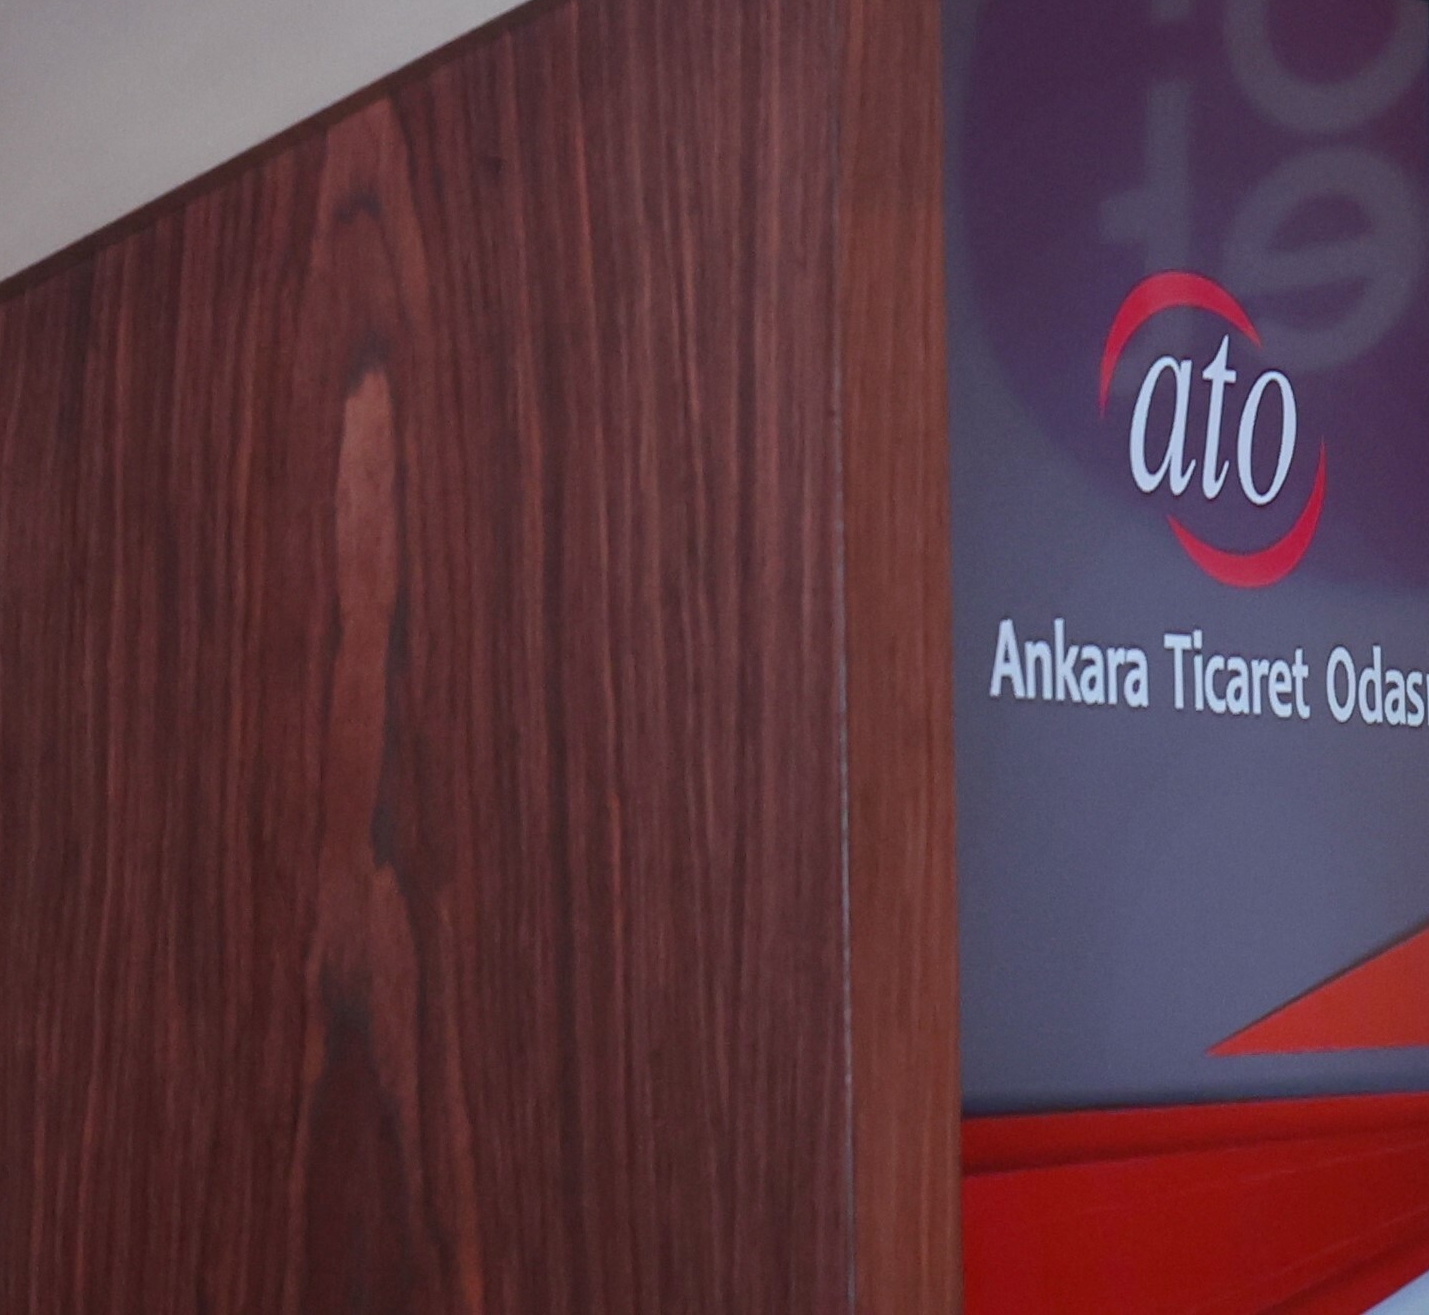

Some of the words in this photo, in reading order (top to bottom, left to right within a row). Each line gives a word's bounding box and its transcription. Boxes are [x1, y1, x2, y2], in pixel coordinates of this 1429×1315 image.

[1129, 334, 1297, 505] ato
[990, 618, 1149, 707] Ankara
[1163, 630, 1311, 719] Ticaret
